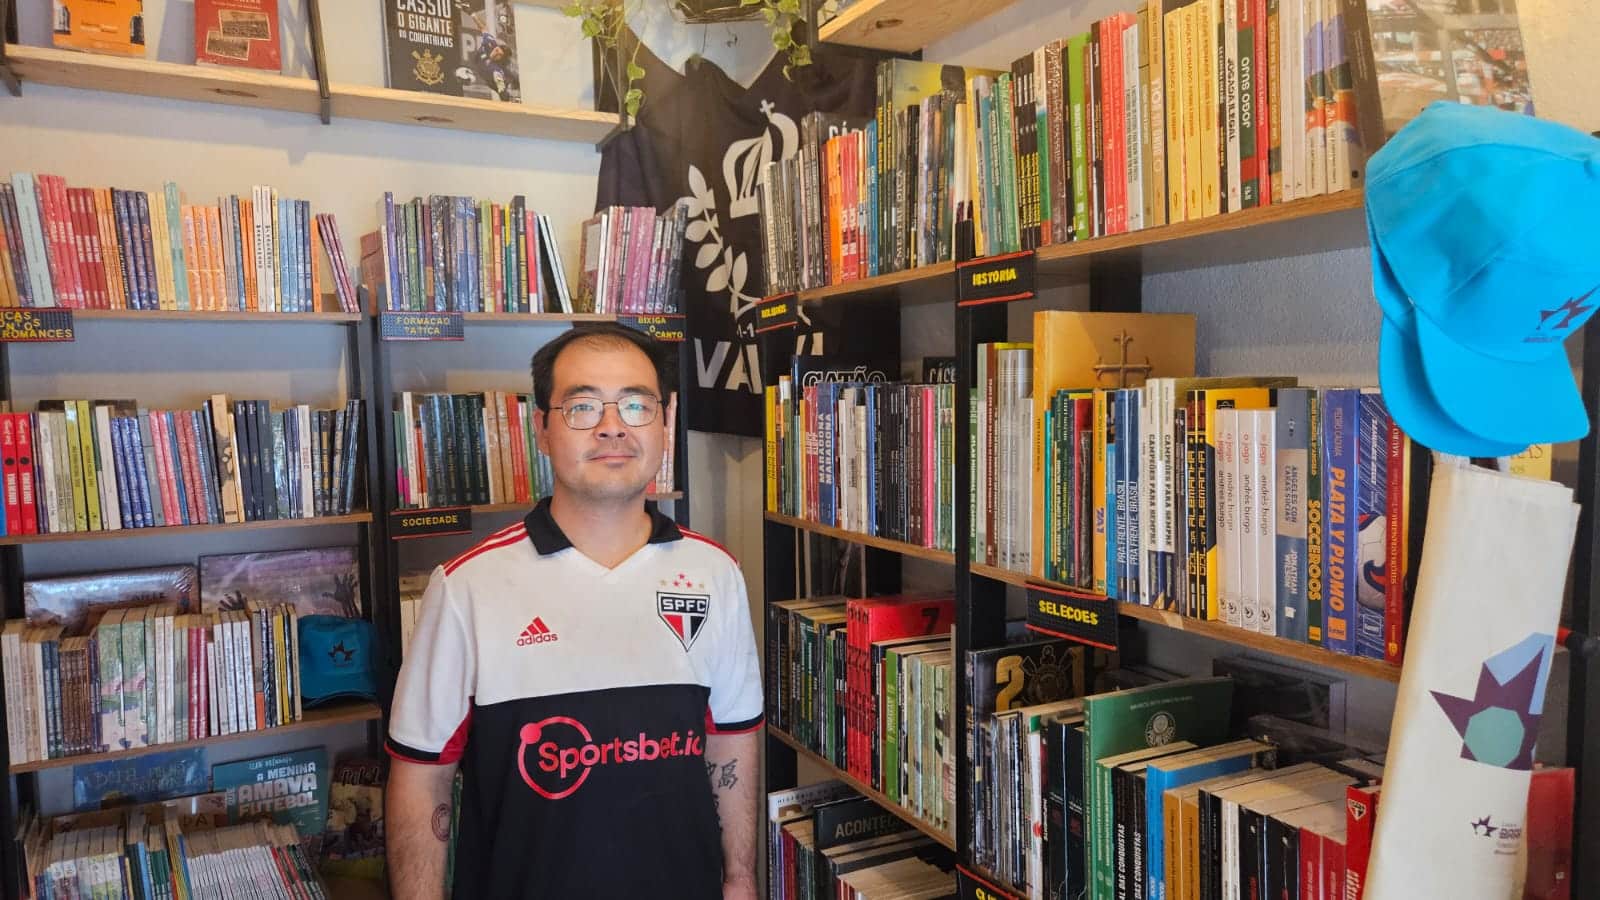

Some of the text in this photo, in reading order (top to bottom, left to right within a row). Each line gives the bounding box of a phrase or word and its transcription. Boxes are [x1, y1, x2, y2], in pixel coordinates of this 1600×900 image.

[409, 14, 453, 36] GIGANTE
[409, 31, 454, 48] CORINTHIANS
[1227, 58, 1237, 142] JOGADA ILEGAL
[1242, 57, 1251, 129] JOGO SUJO
[972, 268, 1017, 286] HISTORIA
[655, 331, 684, 339] CANTO
[1225, 441, 1234, 463] jogo
[1241, 443, 1251, 464] jogo
[1260, 443, 1268, 465] jogo
[1392, 428, 1401, 458] MAURO
[1164, 483, 1172, 508] PARA
[1188, 450, 1197, 527] ALEMANHA
[1198, 450, 1206, 527] ALEMANHA
[402, 515, 459, 527] SOCIEDADE
[1148, 509, 1156, 545] SEMPRE
[1164, 509, 1172, 547] SEMPRE
[1218, 502, 1226, 528] burgo
[1226, 504, 1235, 531] burgo
[1242, 507, 1252, 534] burgo
[1260, 508, 1270, 536] burgo
[1308, 500, 1321, 601] SOCCEROOS
[1328, 467, 1346, 612] PLATA Y PLOMO
[1116, 546, 1127, 564] PRA
[1128, 548, 1138, 565] PRA
[662, 599, 706, 612] SPFC
[1038, 599, 1099, 625] SELECOES
[516, 632, 559, 647] adidas
[268, 762, 316, 779] MENINA
[239, 773, 318, 802] AMAVA
[239, 791, 320, 816] FUTEBOL
[1117, 823, 1126, 873] CONQUISTAS
[1133, 831, 1142, 900] DAS CONQUISTAS
[1117, 874, 1126, 890] DAS
